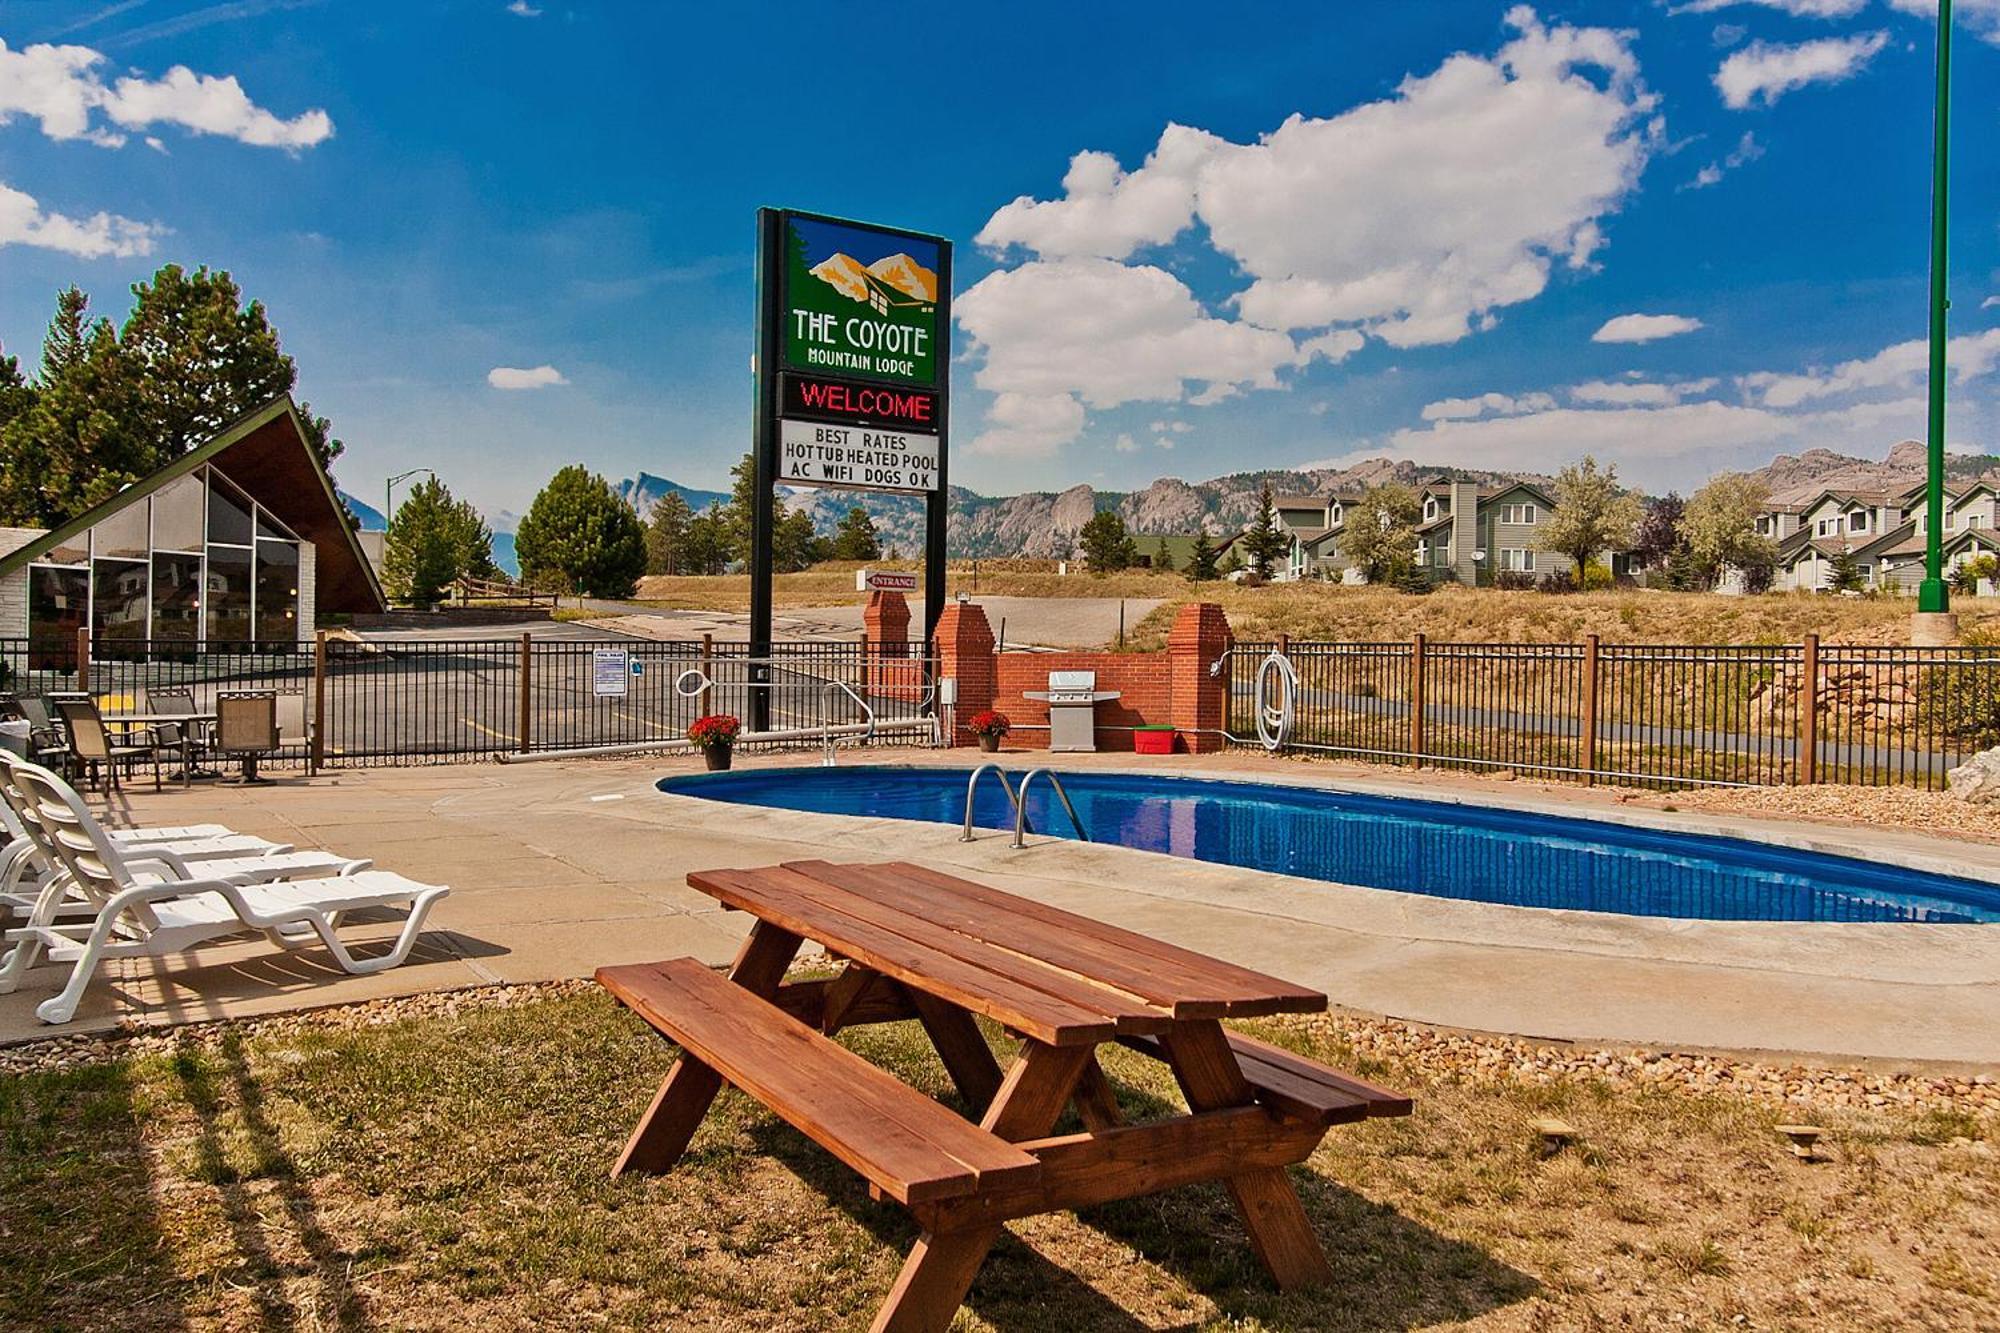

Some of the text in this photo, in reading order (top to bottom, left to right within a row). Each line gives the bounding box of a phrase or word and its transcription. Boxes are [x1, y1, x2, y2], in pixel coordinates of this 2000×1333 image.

[793, 309, 928, 357] THE COYOTE
[808, 347, 914, 376] MOUNTAIN LODGE
[800, 382, 930, 420] WELCOME
[816, 428, 906, 450] BEST RATES
[848, 449, 898, 467] HEATED
[903, 455, 938, 471] POOL
[791, 462, 810, 477] AC
[823, 464, 853, 480] WIFI
[865, 469, 901, 484] DOGS
[872, 576, 914, 587] ENTRANCE
